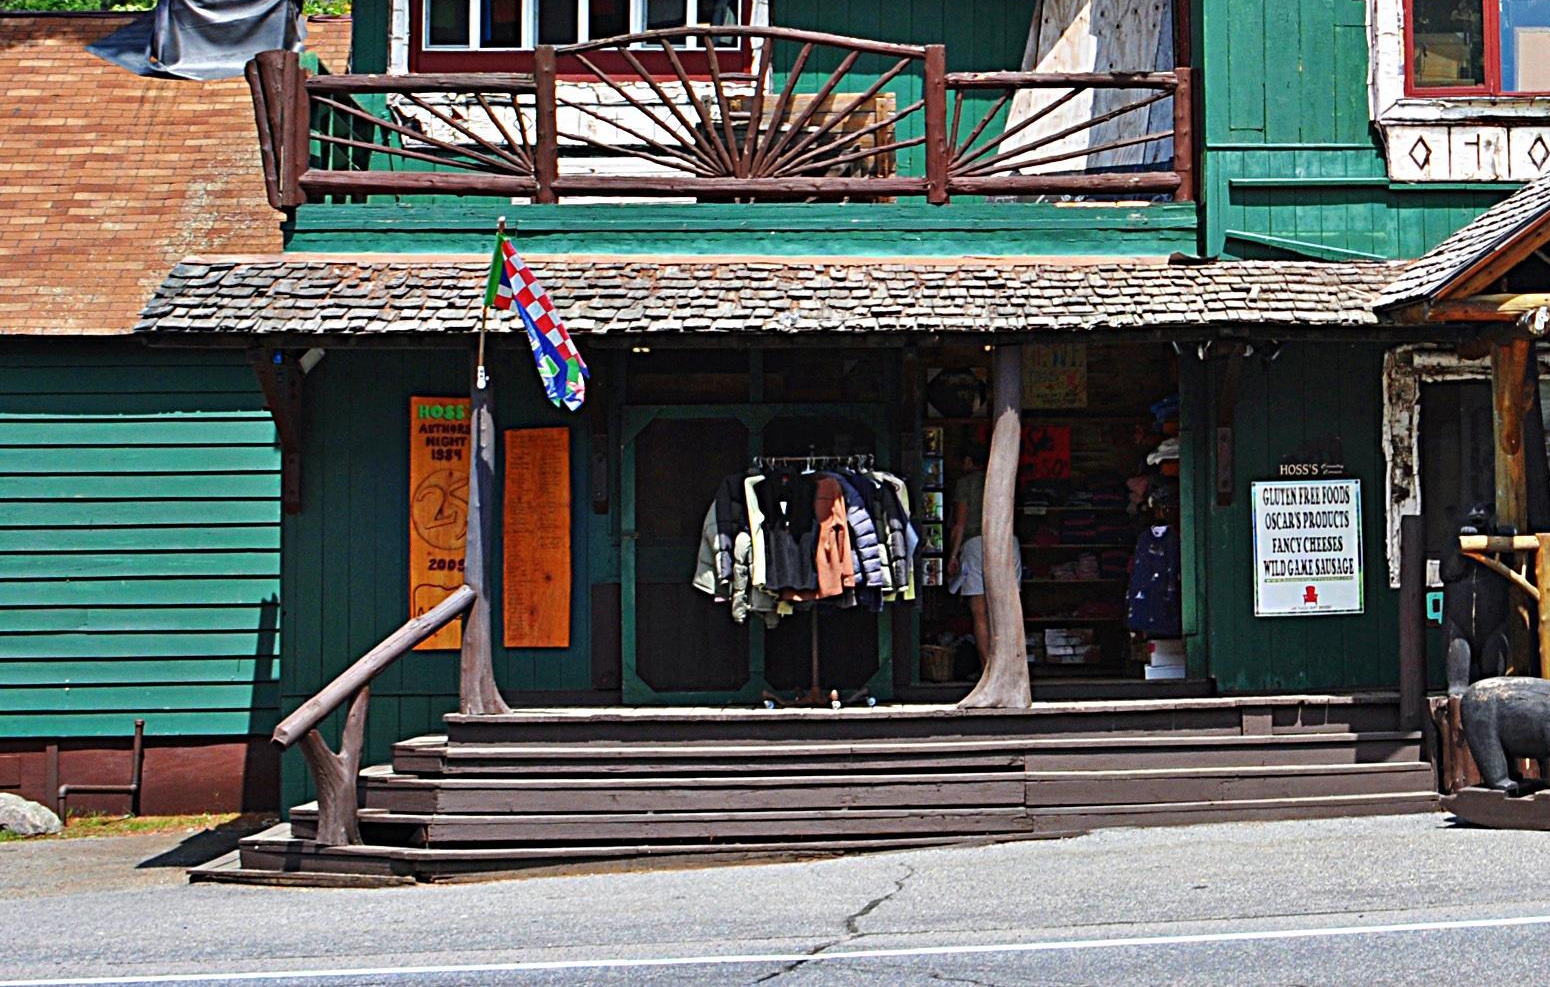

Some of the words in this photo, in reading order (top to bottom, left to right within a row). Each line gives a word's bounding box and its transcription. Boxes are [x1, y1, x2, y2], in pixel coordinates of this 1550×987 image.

[425, 436, 467, 447] NIGHT
[431, 448, 462, 461] 1984
[1280, 463, 1318, 475] HOSS'S
[1263, 487, 1297, 506] GLUTEN
[1298, 486, 1320, 505] FREE
[1322, 485, 1350, 504] FOODS
[1265, 512, 1301, 530] OSCAR'S
[1303, 510, 1350, 529] PRODUCTS
[1272, 537, 1302, 553] FANCY
[1303, 535, 1343, 553] CHEESES
[1263, 560, 1286, 576] WILD
[1287, 559, 1313, 576] GAME
[1315, 558, 1354, 575] SAUSAGE
